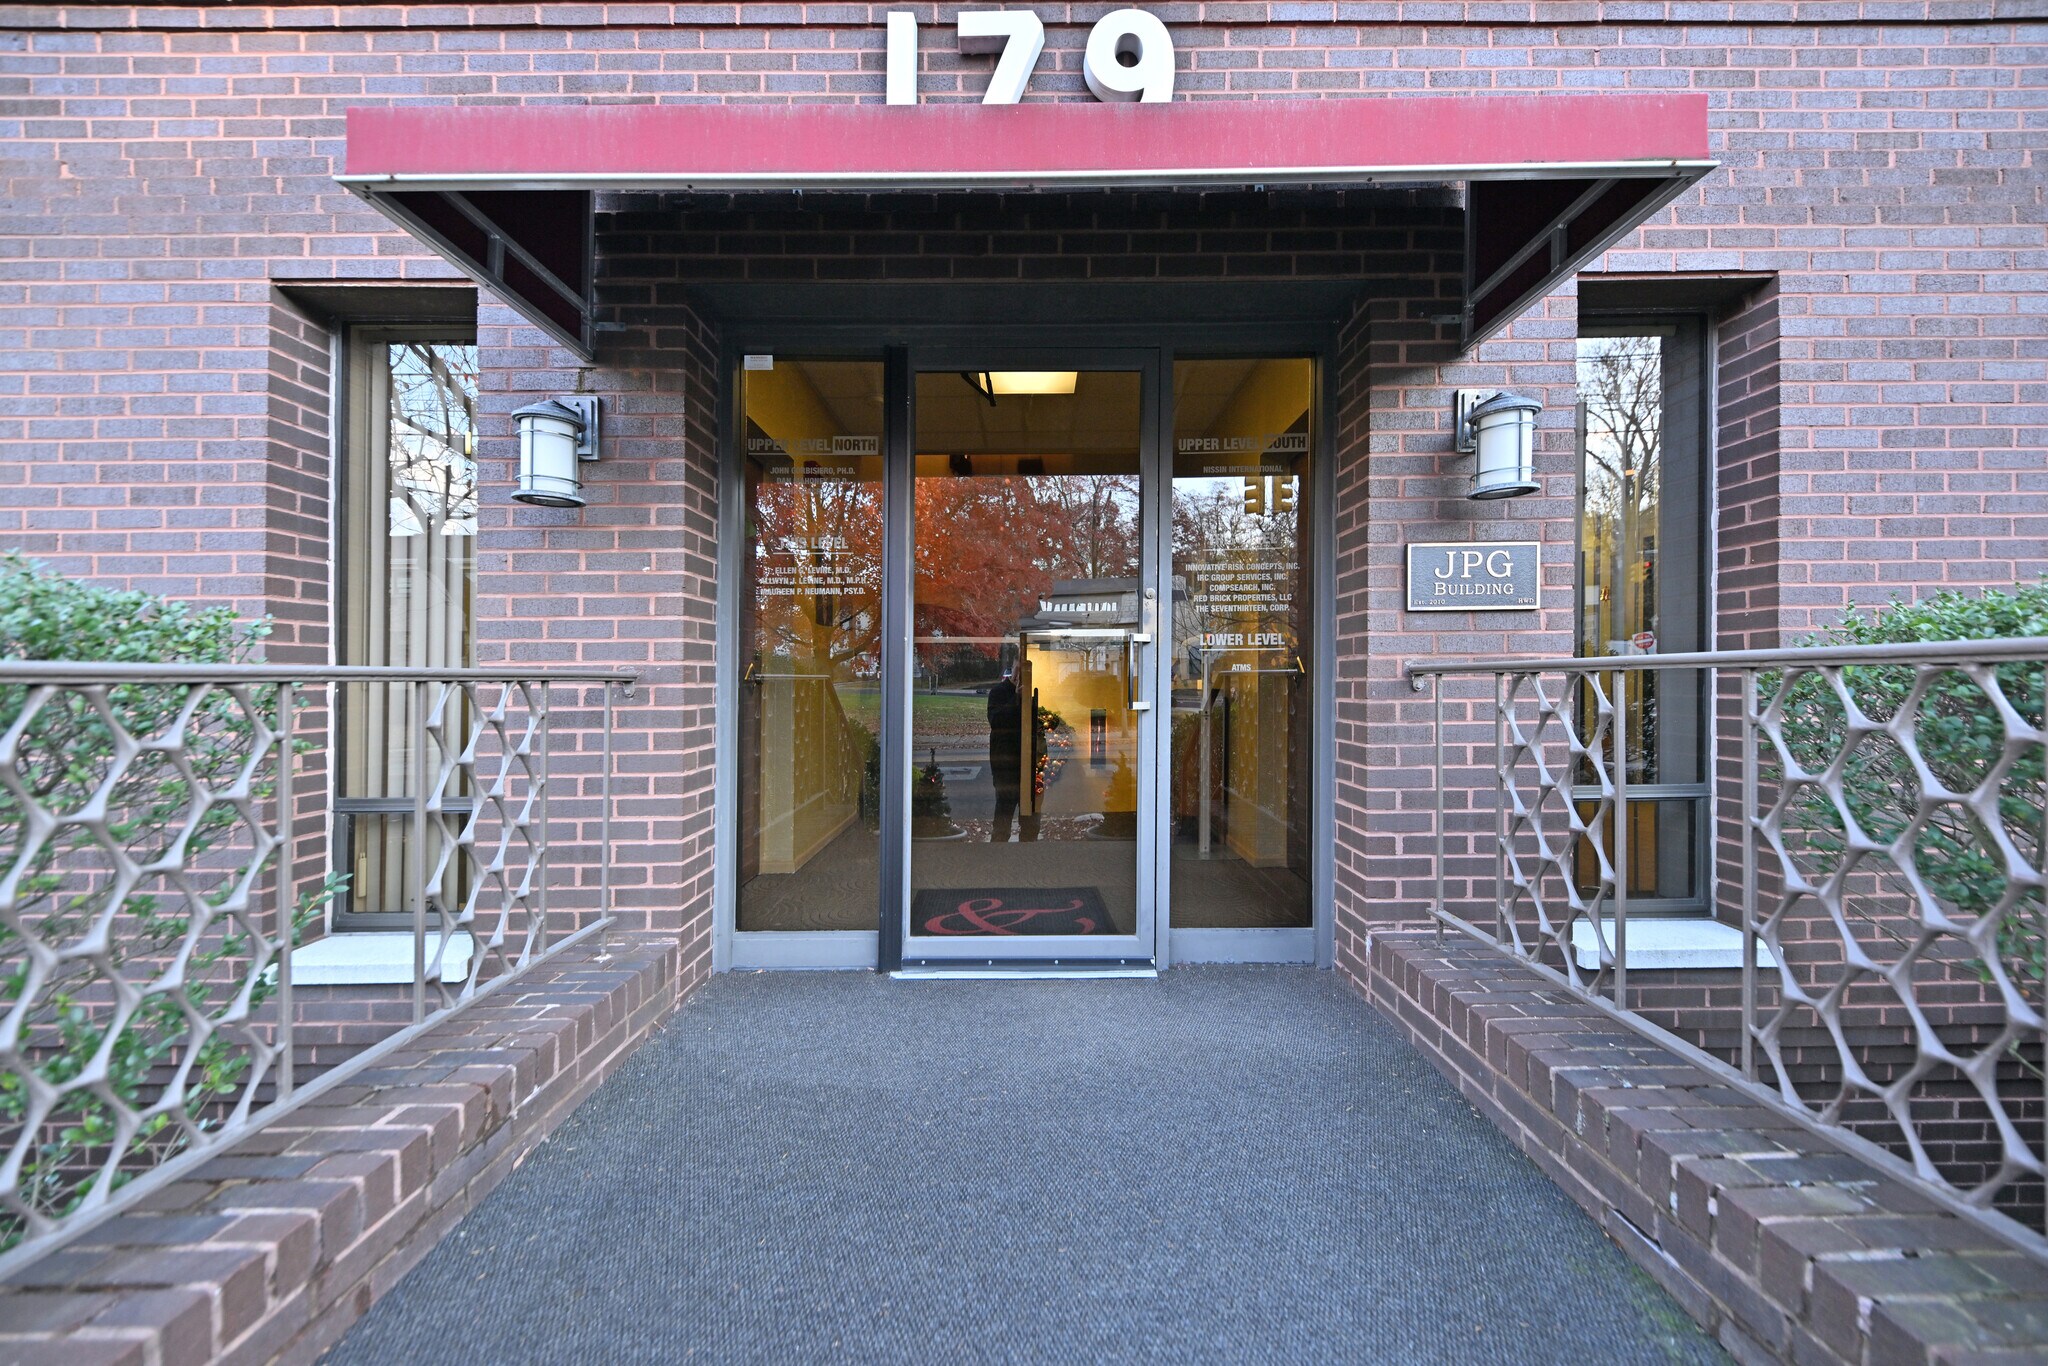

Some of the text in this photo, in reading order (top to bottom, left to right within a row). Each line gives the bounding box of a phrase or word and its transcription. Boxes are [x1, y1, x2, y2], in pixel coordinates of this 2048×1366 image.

[886, 8, 1176, 105] 179
[794, 438, 831, 451] LEVEL
[834, 439, 877, 451] NORTH
[1179, 438, 1219, 451] UPPER
[1224, 437, 1258, 450] LEVEL
[770, 467, 789, 475] JOHN
[837, 467, 856, 475] PH.D.
[1203, 465, 1283, 474] NISSIN INTERNATIONAL
[811, 536, 848, 549] LEVEL
[1186, 561, 1301, 572] INNOVATIVE RISK CONCEPTS, INC.
[1434, 550, 1514, 579] JPG
[808, 567, 834, 575] LEVINE,
[799, 577, 825, 586] LEVINE,
[1197, 572, 1289, 582] IRC GROUP SERVICES, INC.
[805, 587, 842, 597] NEUMANN,
[844, 587, 866, 595] PSY.D.
[1210, 584, 1260, 592] COMPSEARCH,
[1434, 582, 1514, 596] BUILDING
[1194, 593, 1292, 603] RED BRICK PROPERTIES, LLC
[1196, 605, 1209, 613] THE
[1270, 604, 1290, 612] CORP.
[1200, 633, 1286, 646] LOWER LEVEL
[1231, 664, 1252, 672] ATMS
